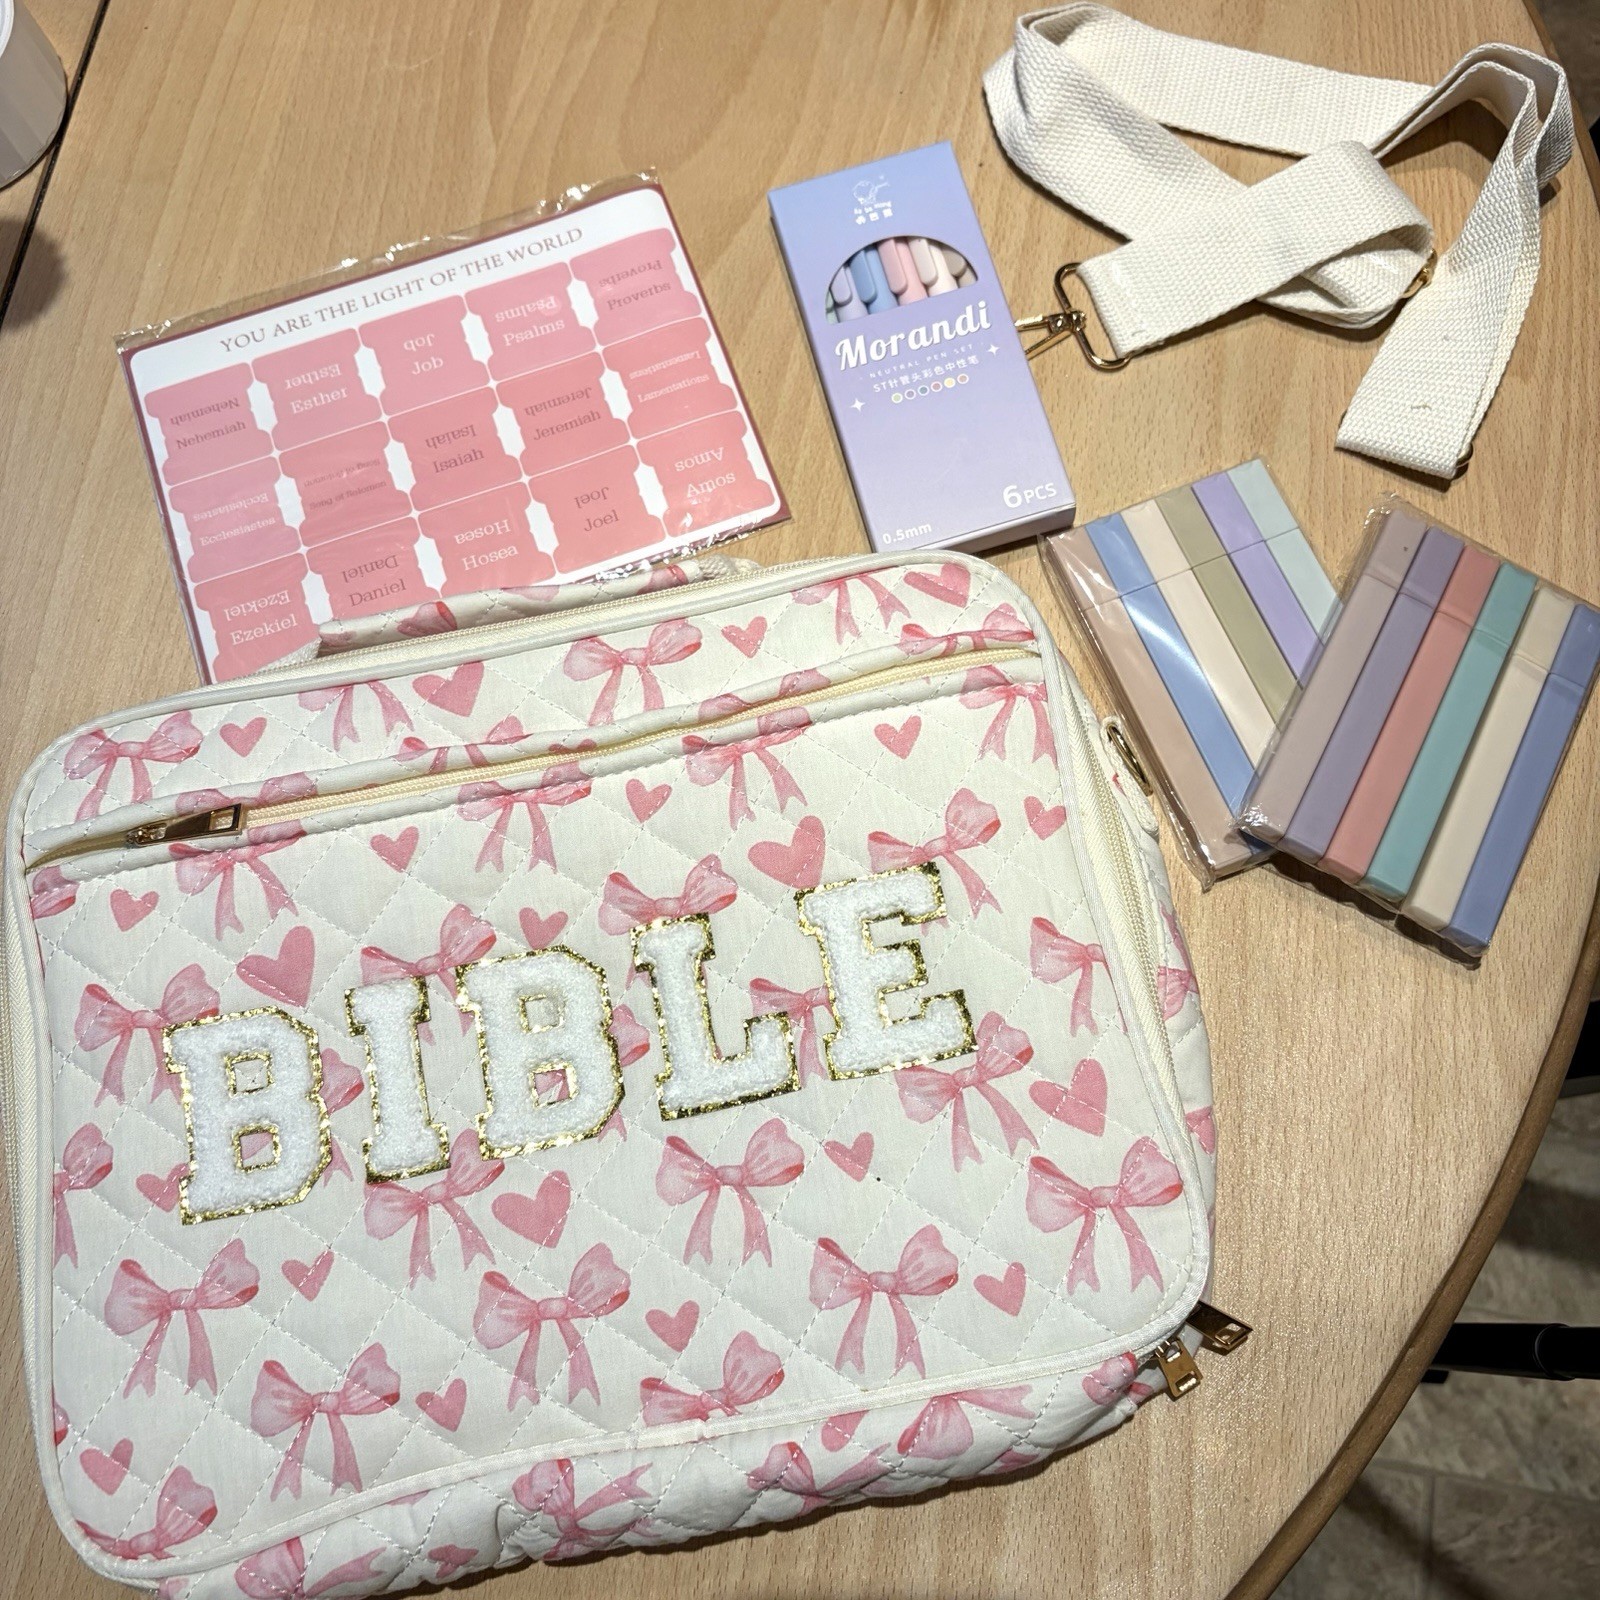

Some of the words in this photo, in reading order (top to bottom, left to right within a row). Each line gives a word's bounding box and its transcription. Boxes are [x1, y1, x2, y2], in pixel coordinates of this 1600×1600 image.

[220, 328, 266, 352] YOU
[273, 313, 313, 338] ARE
[315, 299, 359, 324] THE
[362, 278, 425, 309] LIGHT
[430, 268, 458, 288] OF
[460, 254, 505, 277] THE
[506, 228, 584, 263] WORLD
[607, 281, 672, 310] Proverbs
[503, 319, 565, 346] Psalms
[834, 300, 992, 371] Morandi
[412, 357, 444, 375] Job
[869, 360, 920, 378] NEUTRAL
[926, 351, 948, 362] PEN
[953, 343, 974, 354] SET
[291, 387, 348, 414] Esther
[176, 420, 246, 450] Nehemiah
[534, 410, 601, 441] Jeremiah
[433, 448, 485, 474] Isaiah
[686, 471, 736, 498] Amos
[583, 510, 619, 532] Joel
[882, 523, 932, 545] 0.5mm
[463, 544, 519, 570] Hosea
[349, 578, 406, 608] Daniel
[231, 614, 298, 646] Ezekiel
[162, 861, 978, 1225] BIBLE
